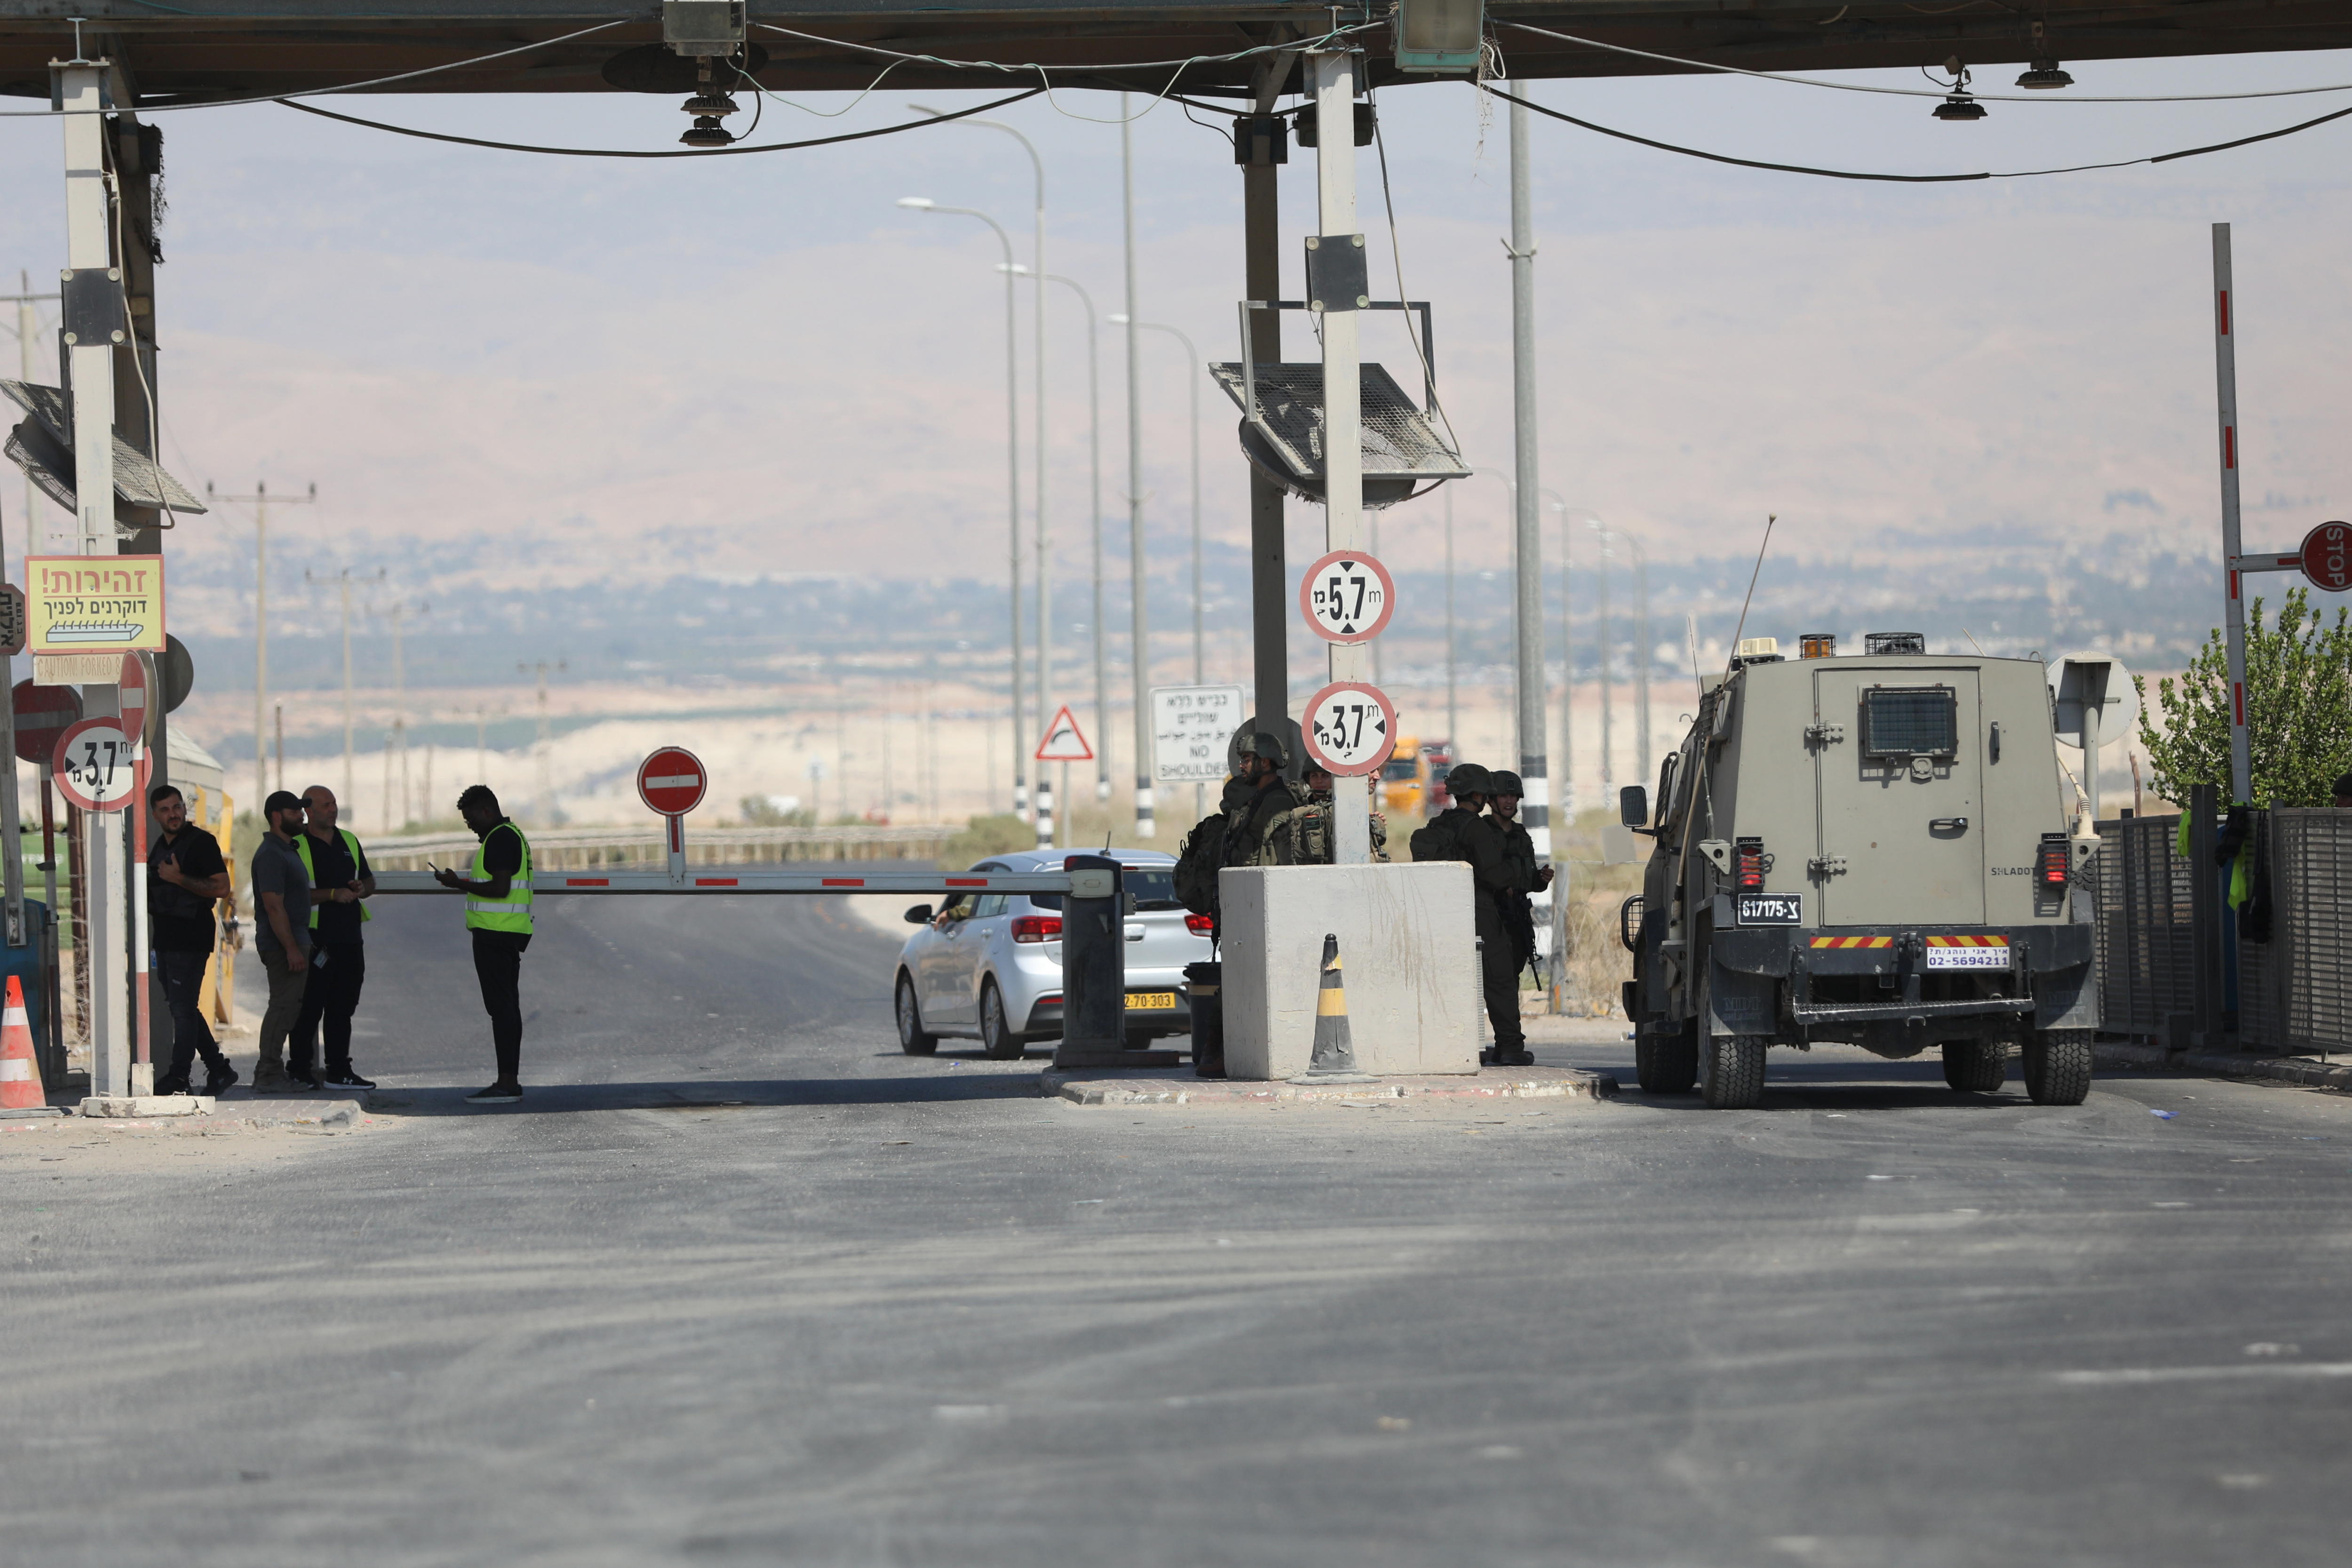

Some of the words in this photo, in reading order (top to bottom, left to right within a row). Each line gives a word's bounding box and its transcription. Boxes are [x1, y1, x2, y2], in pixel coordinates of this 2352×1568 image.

[2326, 527, 2345, 585] STOP
[42, 568, 147, 593] זהירות!
[44, 597, 84, 620] לפניך
[90, 600, 147, 618] דוקרנים
[1329, 577, 1366, 621] 5.7
[1369, 590, 1382, 603] m
[81, 656, 112, 677] FORKED
[1332, 705, 1364, 749] 3.7
[1367, 705, 1379, 717] m
[1189, 745, 1209, 758] NO
[85, 741, 117, 786] 3.7
[1991, 867, 2036, 876] SHLADOT
[1929, 956, 2008, 965] 02-5694211
